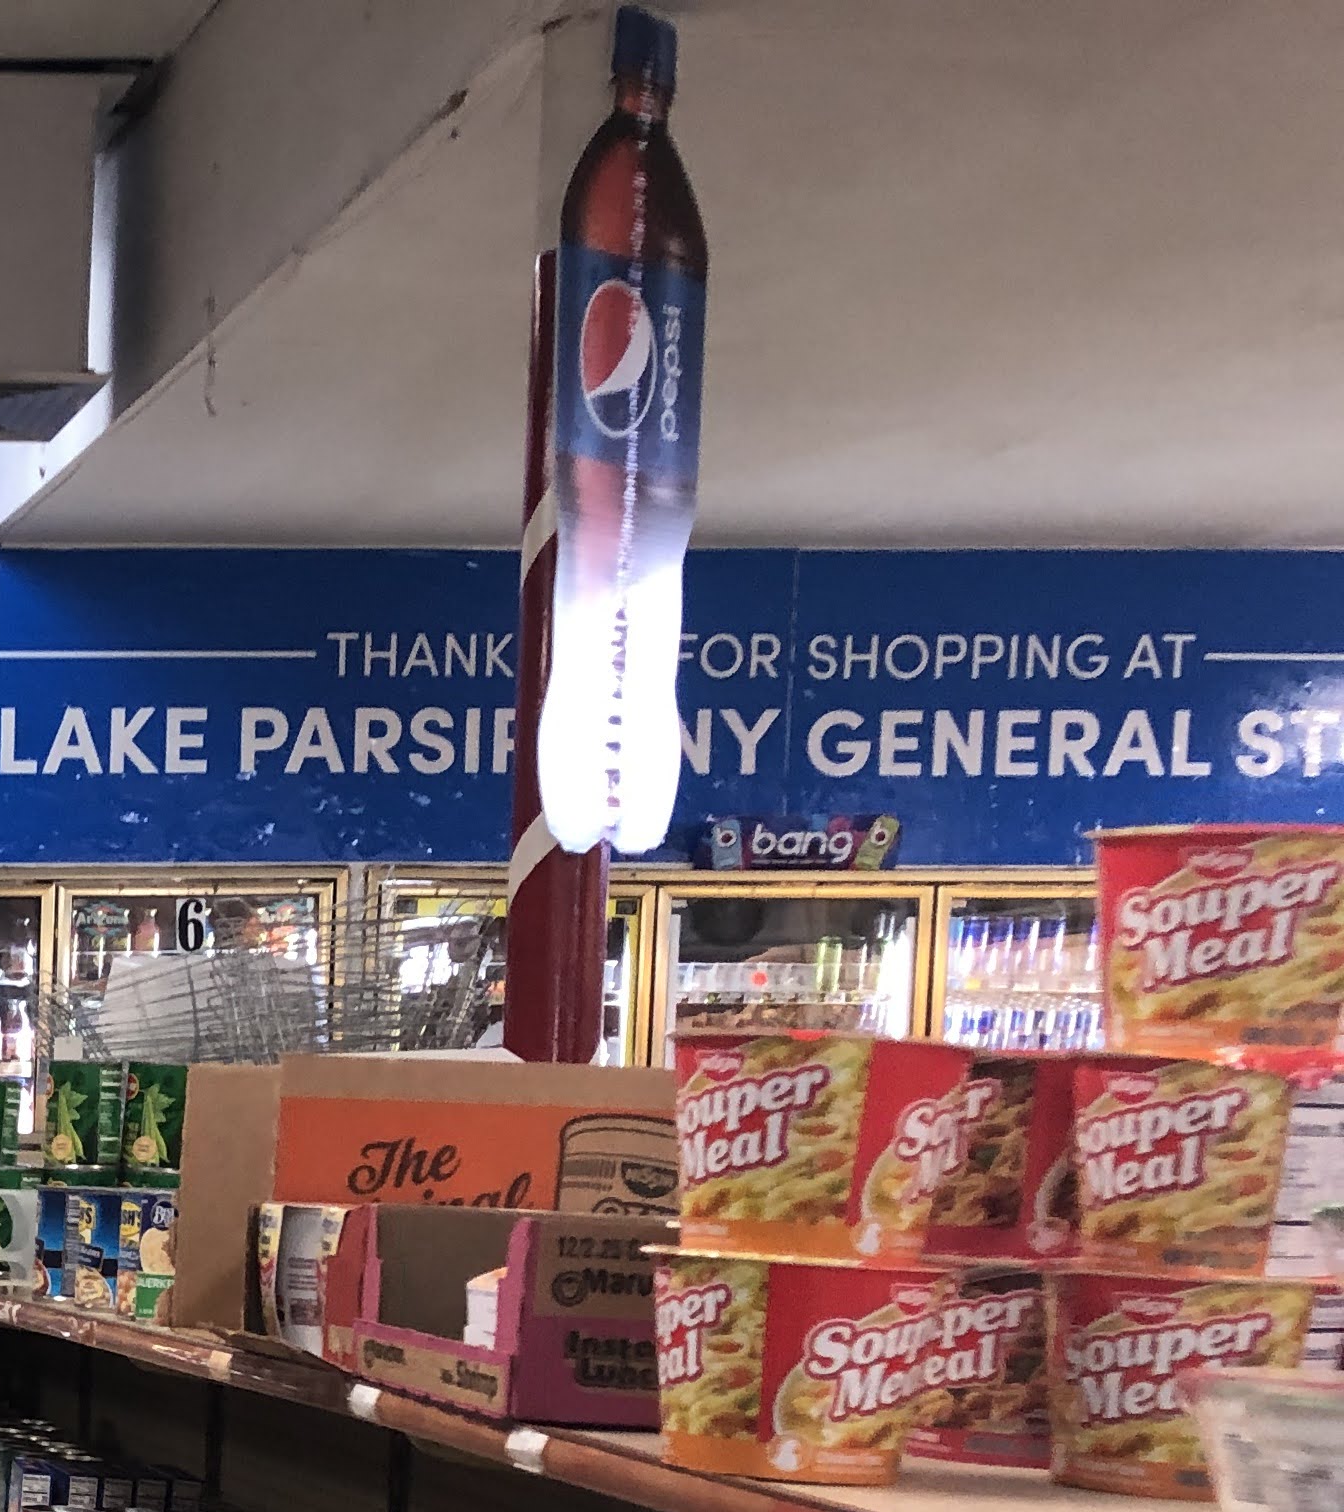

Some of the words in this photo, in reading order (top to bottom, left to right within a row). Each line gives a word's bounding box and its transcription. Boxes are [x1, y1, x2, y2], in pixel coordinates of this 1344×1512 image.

[660, 304, 683, 442] pepsi
[326, 631, 514, 678] THANK
[808, 633, 1110, 681] SHOPPING
[1124, 634, 1196, 679] AT
[808, 709, 1211, 778] GENERAL
[1236, 709, 1344, 778] ST
[751, 822, 854, 863] bang
[177, 899, 204, 952] 6
[1118, 860, 1342, 950] Souper
[1140, 912, 1294, 993] Meal
[347, 1137, 462, 1195] The
